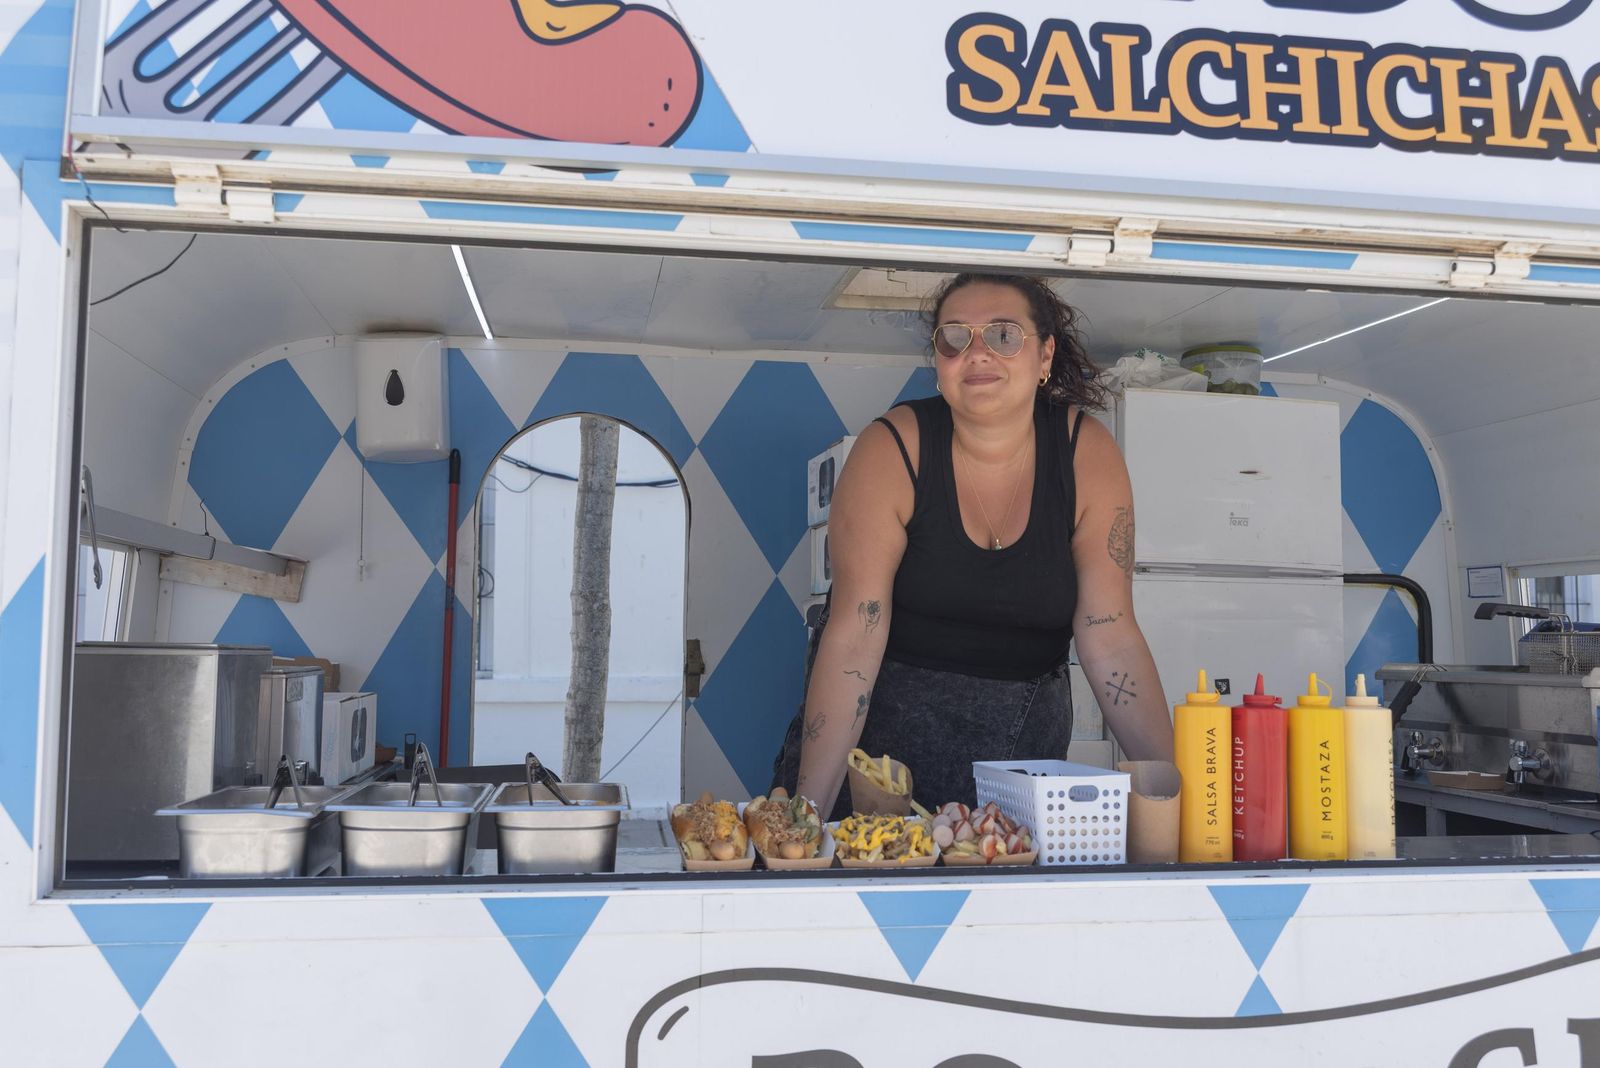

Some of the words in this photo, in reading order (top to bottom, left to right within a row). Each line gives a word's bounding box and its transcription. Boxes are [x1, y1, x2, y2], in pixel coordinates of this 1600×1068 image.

[949, 16, 1600, 158] SALCHICHA
[1206, 727, 1217, 774] BRAVA
[1234, 736, 1245, 815] KETCHUP
[1319, 739, 1333, 822] MOSTAZA
[1206, 781, 1218, 826] SALSA
